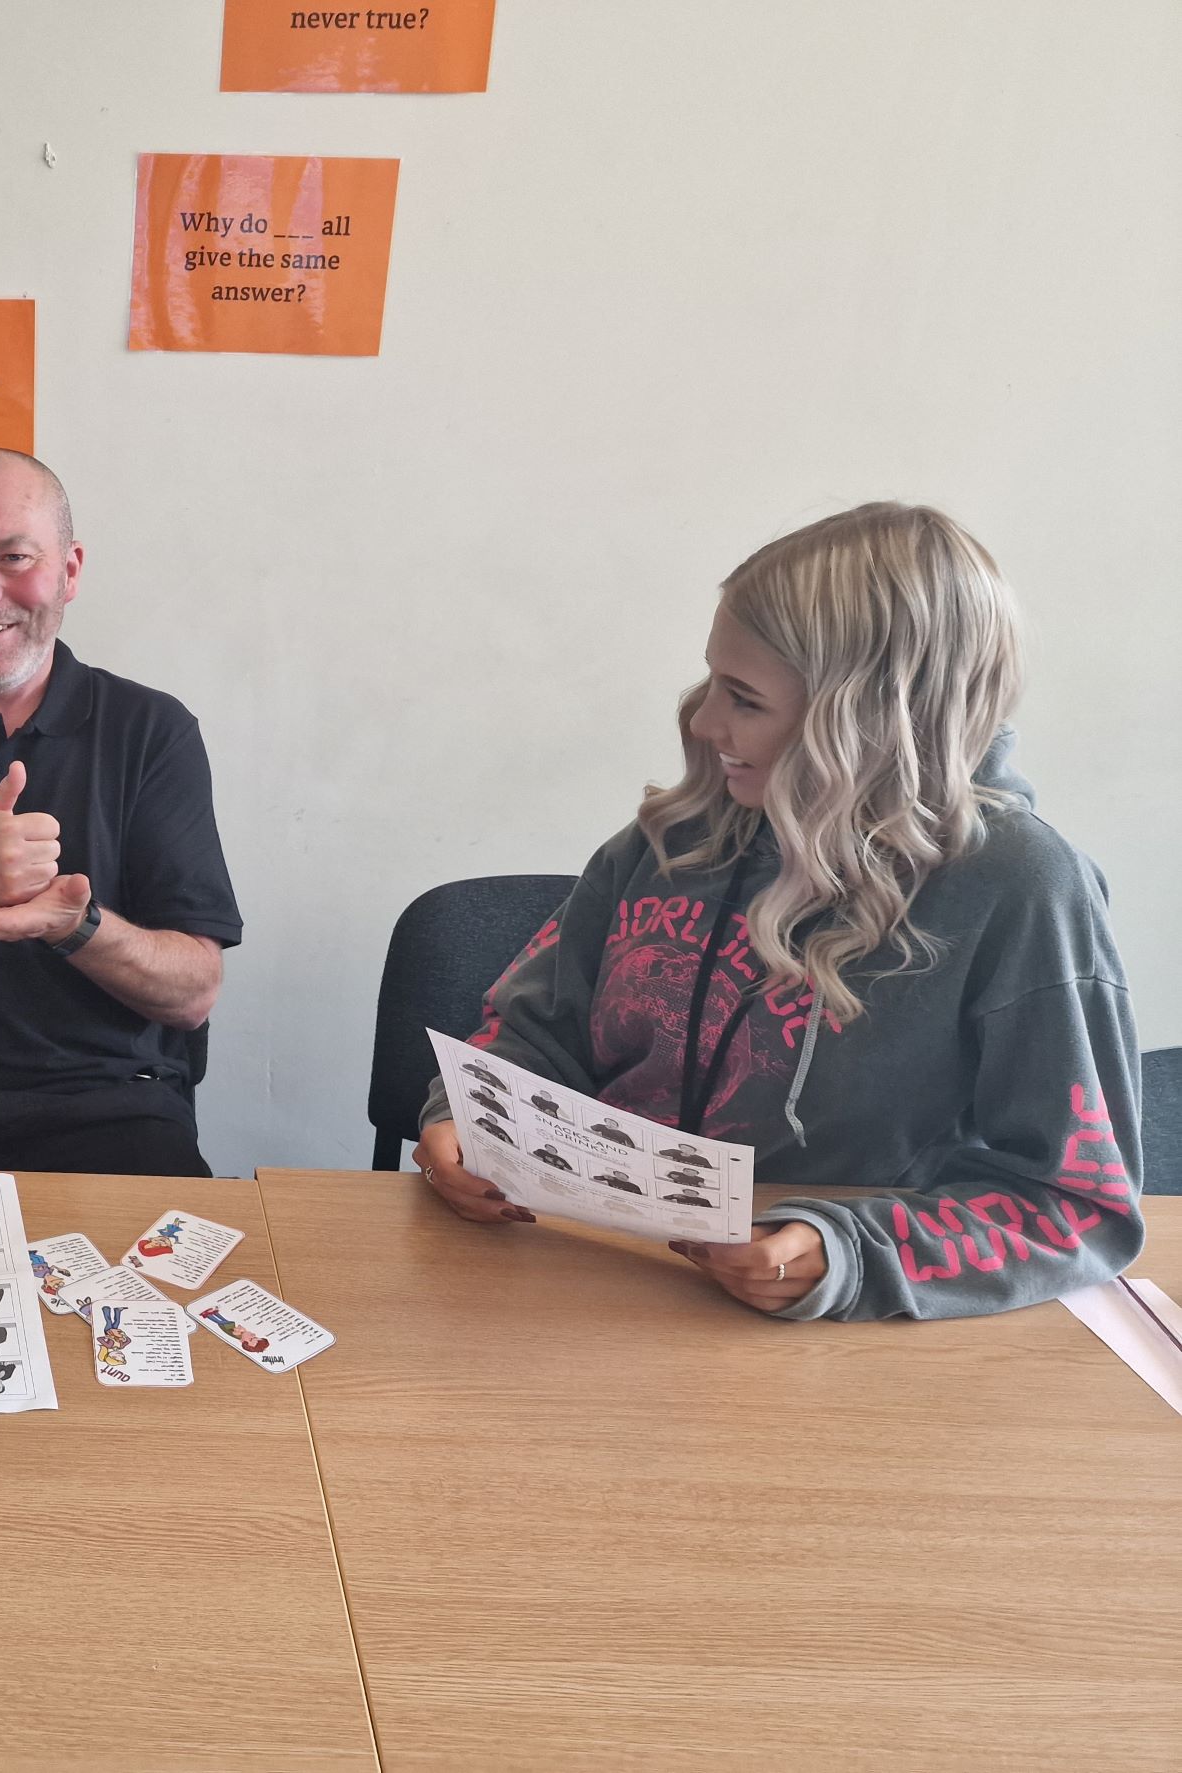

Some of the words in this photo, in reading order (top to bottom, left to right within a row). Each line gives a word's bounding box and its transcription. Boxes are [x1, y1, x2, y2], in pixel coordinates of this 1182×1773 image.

[291, 9, 359, 31] never
[365, 8, 430, 31] true?
[179, 211, 235, 237] Why
[239, 212, 268, 235] do
[322, 215, 351, 237] all
[184, 247, 231, 271] give
[237, 248, 276, 269] the
[280, 252, 341, 271] same
[211, 283, 306, 304] answer?
[534, 1114, 590, 1142] SNACKS
[596, 1141, 629, 1156] AND
[554, 1129, 608, 1155] DRINKS
[261, 1354, 285, 1366] brother
[100, 1365, 131, 1383] aunt
